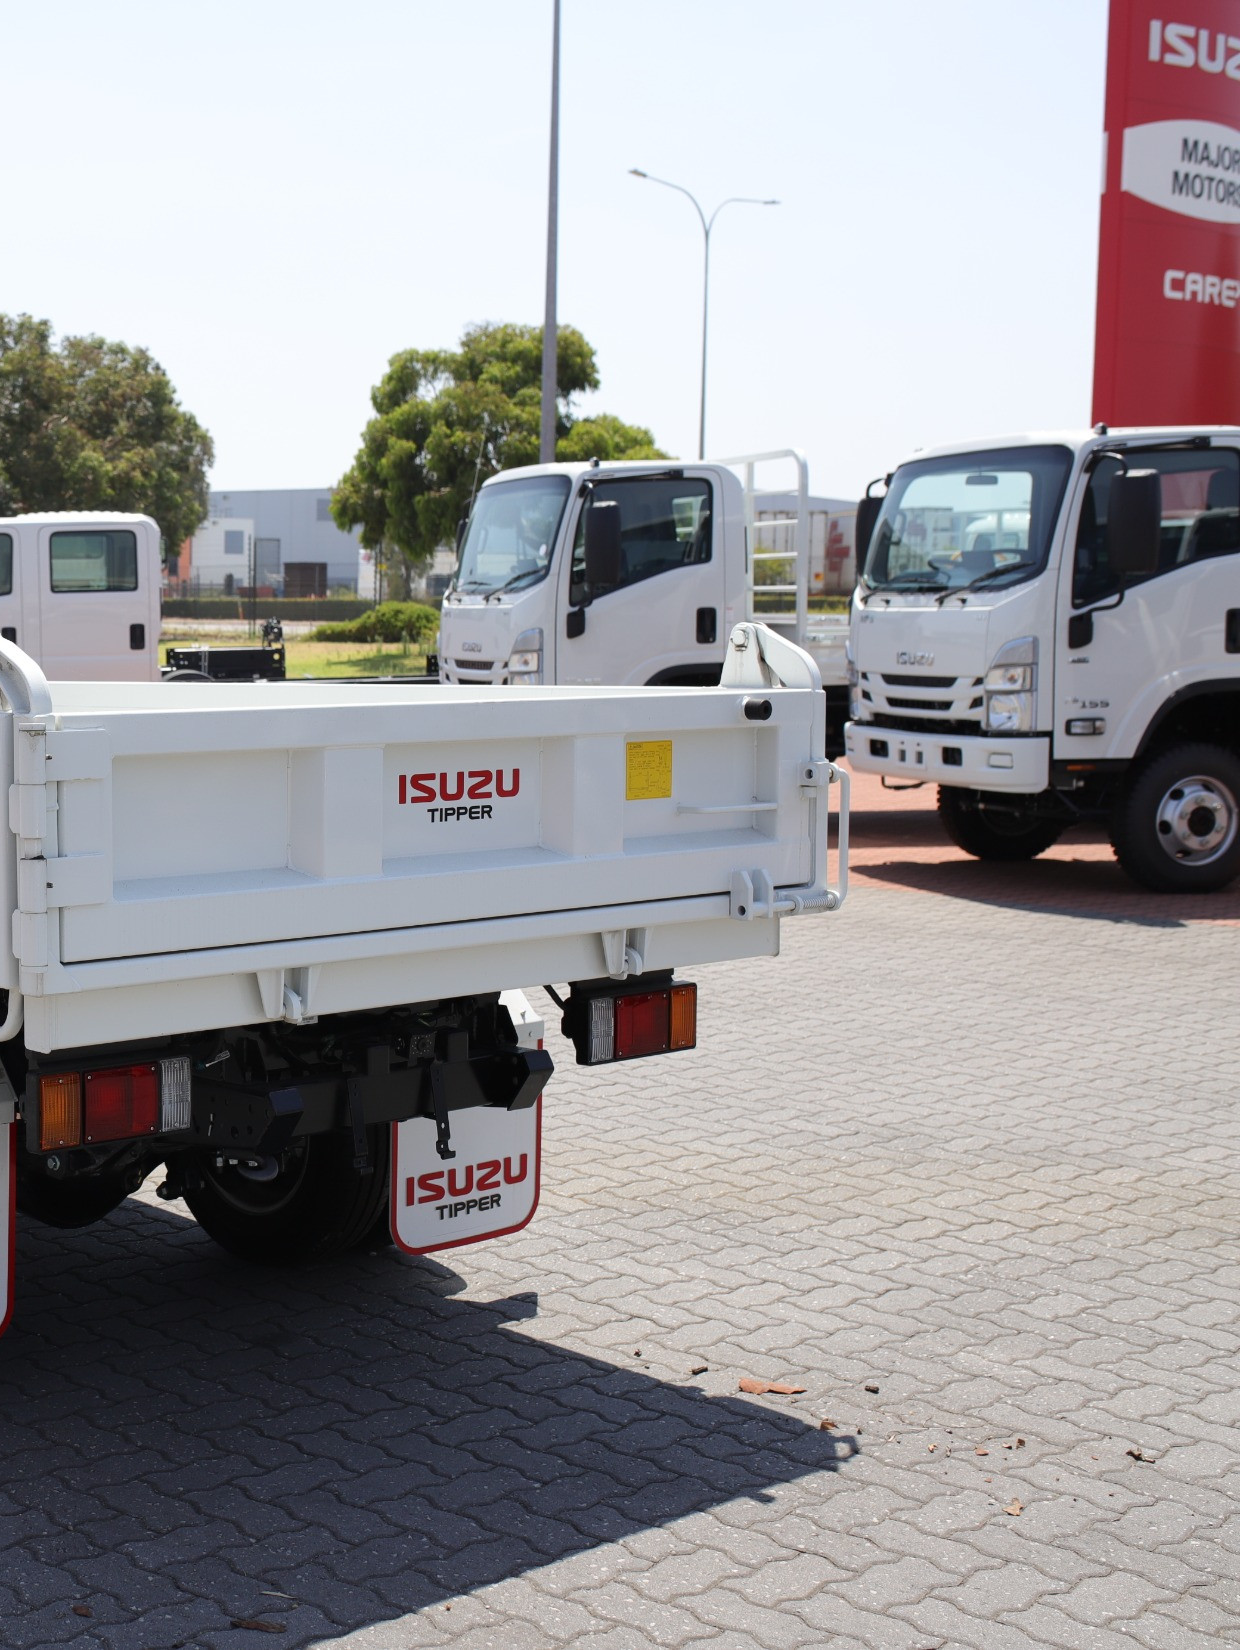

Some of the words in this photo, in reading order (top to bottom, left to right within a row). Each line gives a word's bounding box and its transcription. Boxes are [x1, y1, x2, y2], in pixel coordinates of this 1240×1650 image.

[1181, 137, 1240, 174] MAJOR
[1163, 268, 1240, 308] CARE
[896, 651, 935, 666] ISUZU
[398, 768, 520, 804] ISUZU
[427, 804, 493, 822] TIPPER
[405, 1153, 528, 1206] ISUZU
[435, 1193, 502, 1220] TIPPER
